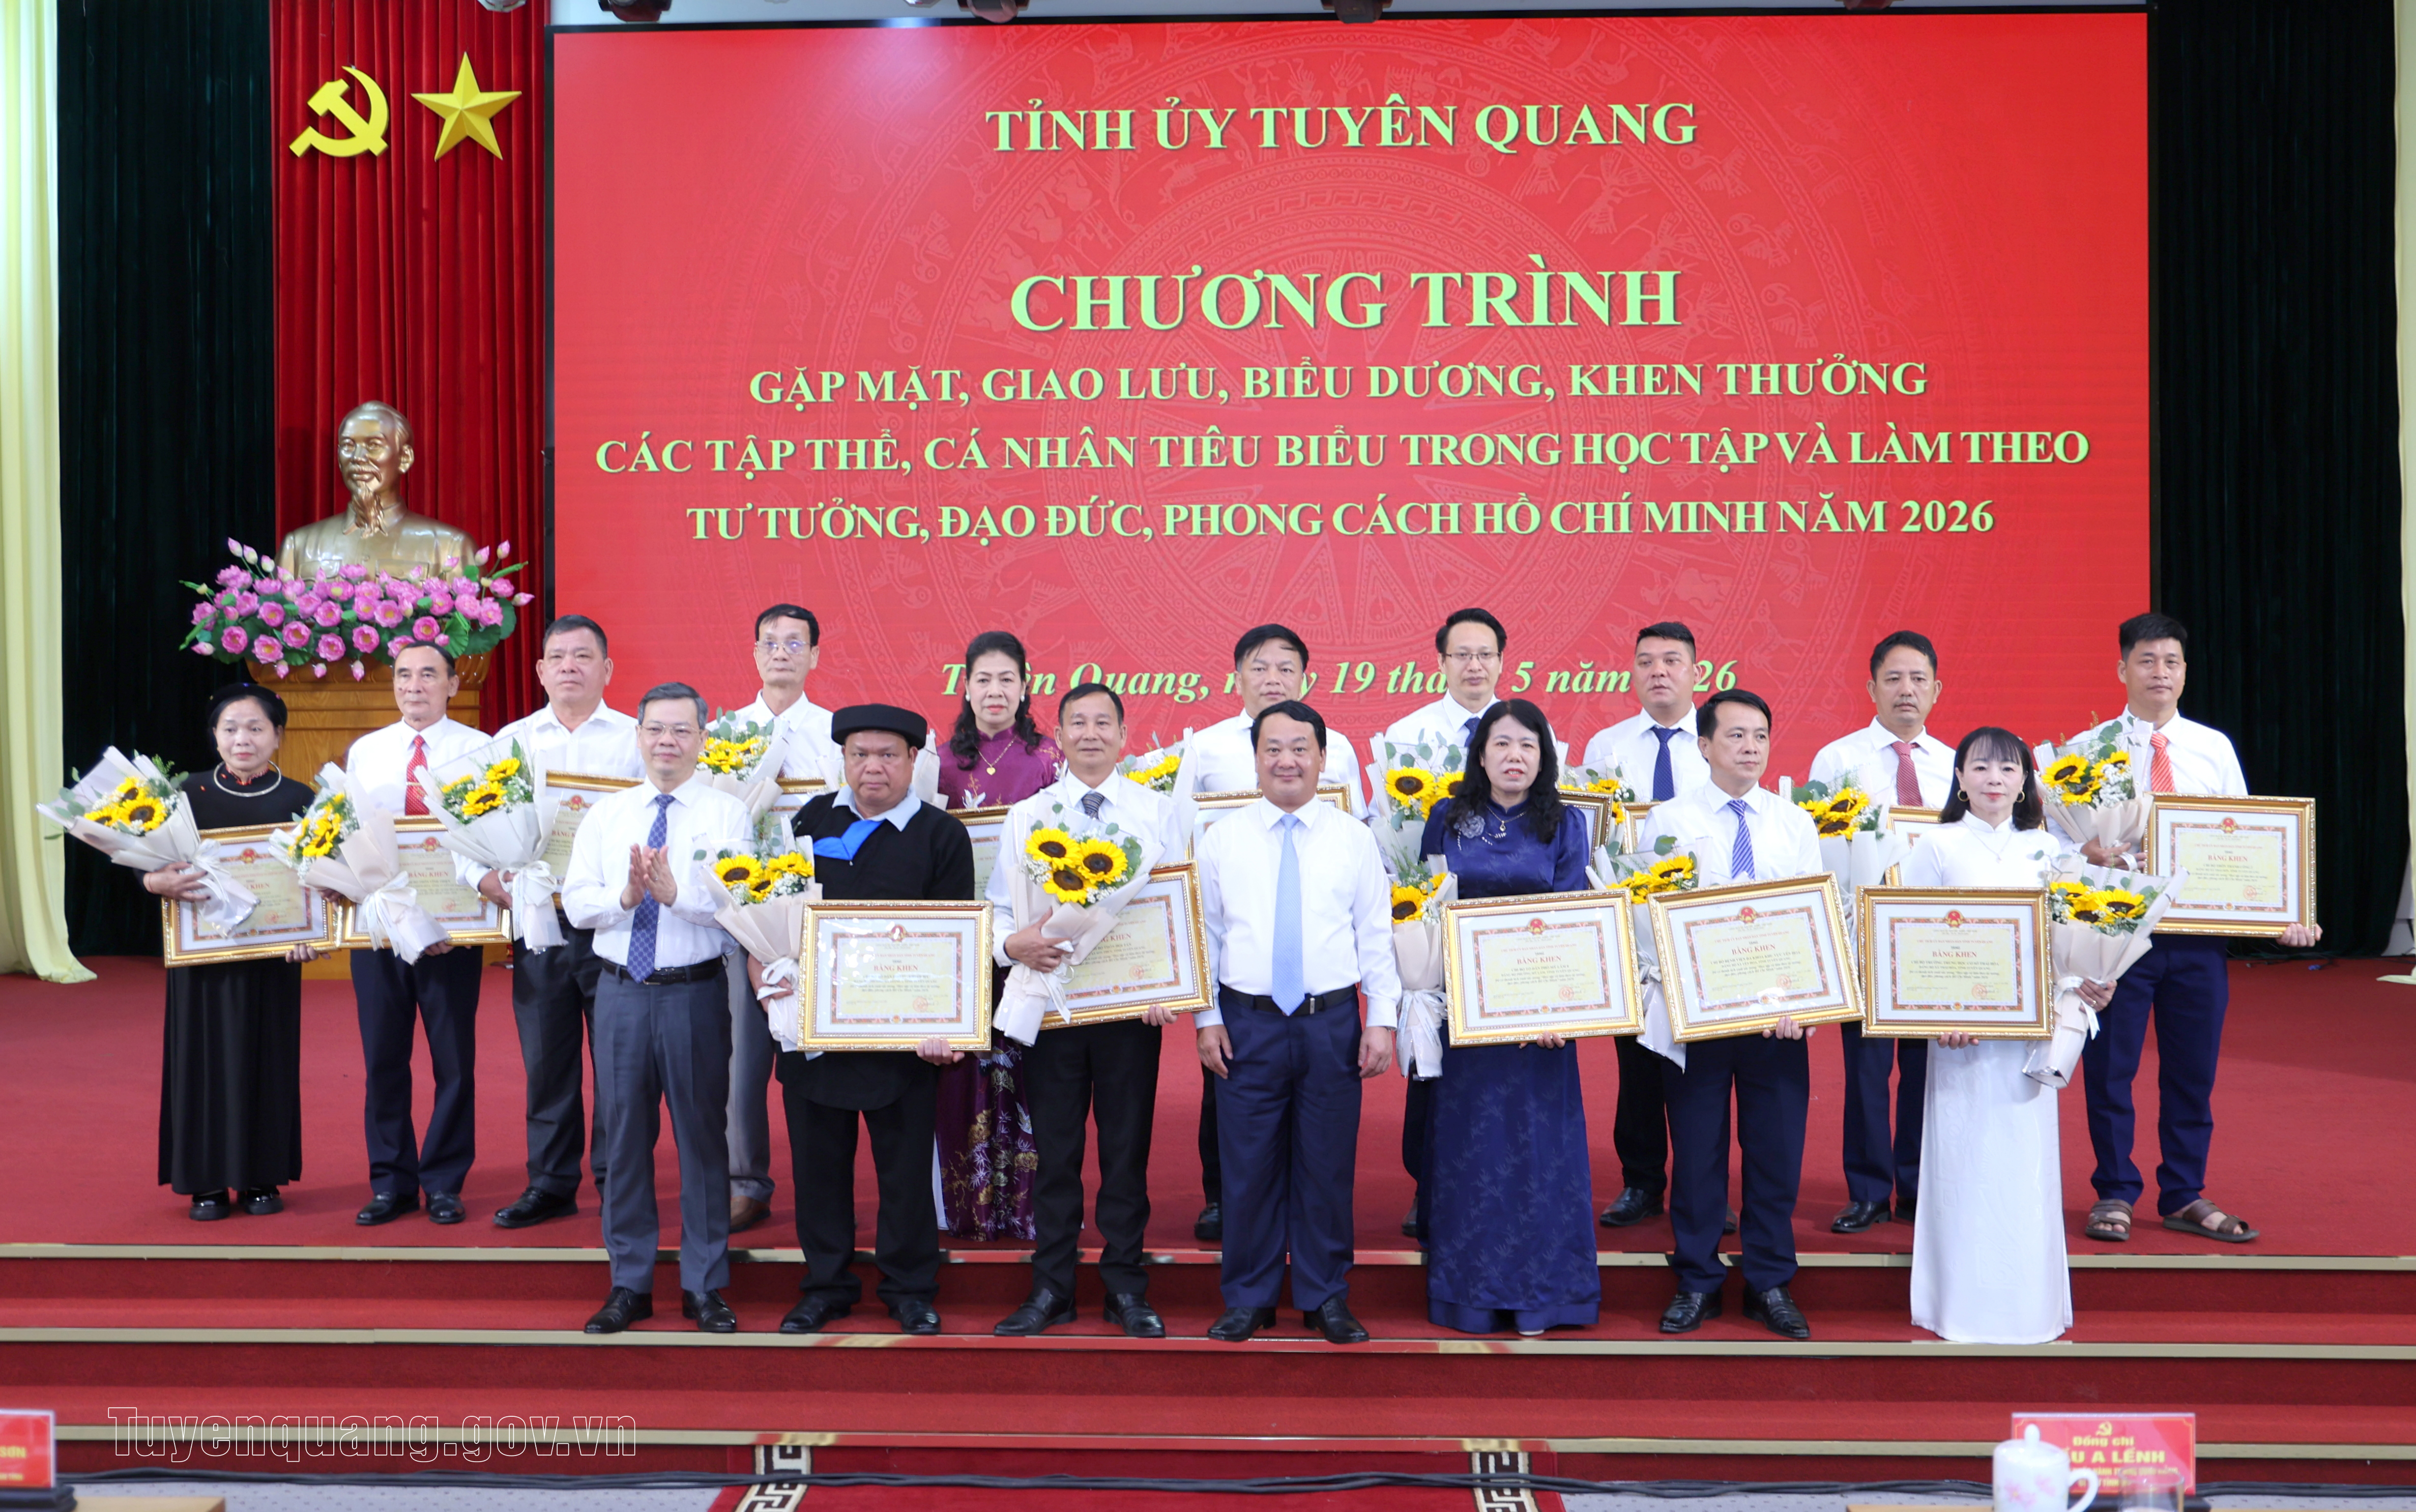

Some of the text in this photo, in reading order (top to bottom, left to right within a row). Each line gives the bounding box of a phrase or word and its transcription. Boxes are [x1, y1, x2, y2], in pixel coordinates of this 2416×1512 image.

[985, 93, 1697, 154] TỈNH ỦY TUYÊN QUANG
[1010, 253, 1682, 332] CHƯƠNG TRÌNH
[750, 353, 1927, 412] GẶP MẶT, GIAO LƯU, BIỂU DƯƠNG, KHEN THƯỞNG
[596, 421, 2089, 480] CÁC TẬP THỂ, CÁ NHÂN TIÊU BIỂU TRONG HỌC TẬP VÀ LÀM THEO
[686, 489, 1994, 547] TƯ TƯỞNG, ĐẠO ĐỨC, PHONG CÁCH HỒ CHÍ MINH NĂM 2026
[1329, 661, 1376, 693] 19
[1510, 661, 1535, 693] 5
[1546, 661, 1631, 693] năm
[1692, 660, 1738, 692] 26
[1755, 944, 1775, 952] KHEN
[2091, 1450, 2106, 1463] A
